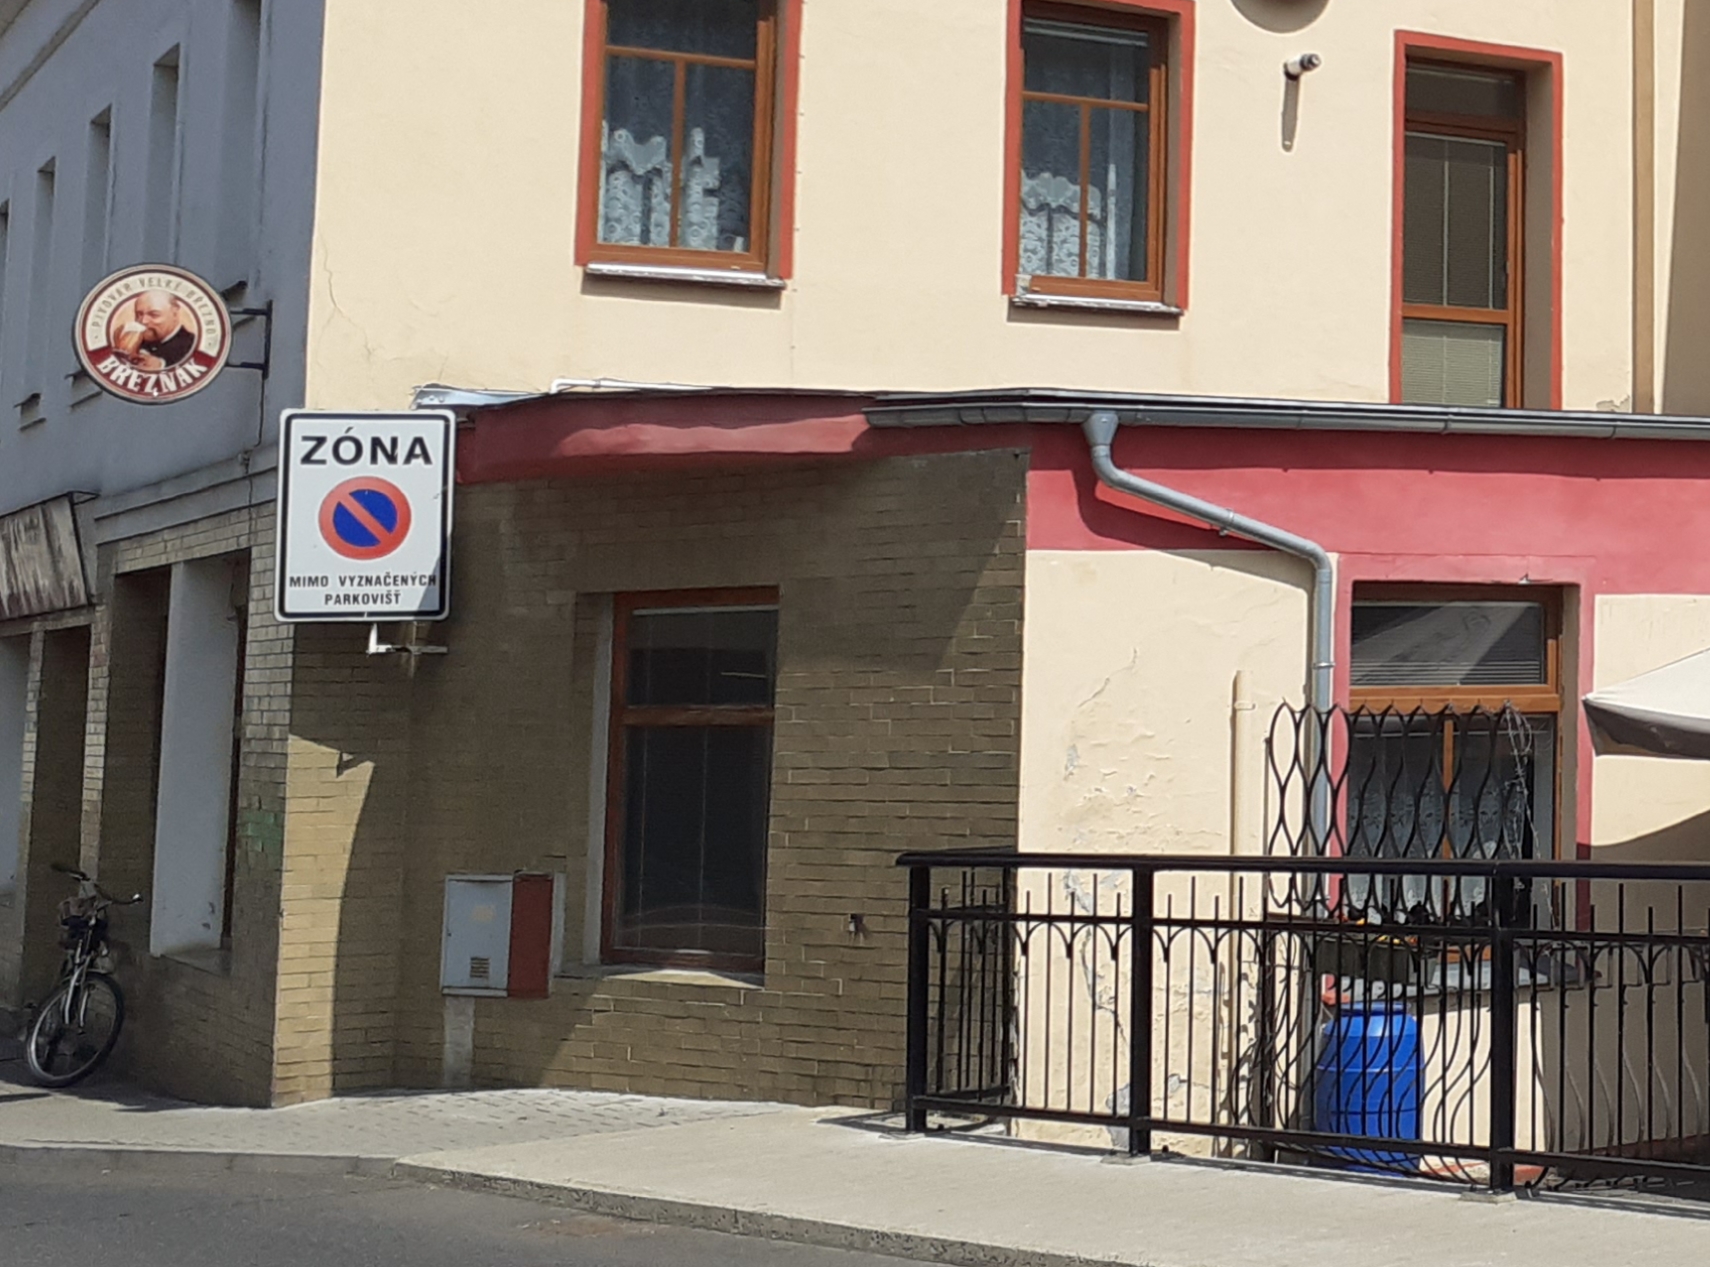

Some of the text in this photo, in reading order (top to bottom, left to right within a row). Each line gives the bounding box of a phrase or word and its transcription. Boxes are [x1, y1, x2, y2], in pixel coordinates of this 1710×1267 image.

[92, 282, 132, 329] PIVOVAR
[96, 355, 208, 393] BŘEZŇÁK
[300, 426, 433, 465] ZÓNA
[289, 572, 437, 588] MIMO VYZNAČENÝCH
[324, 590, 401, 605] PARKOVIŠŤ
